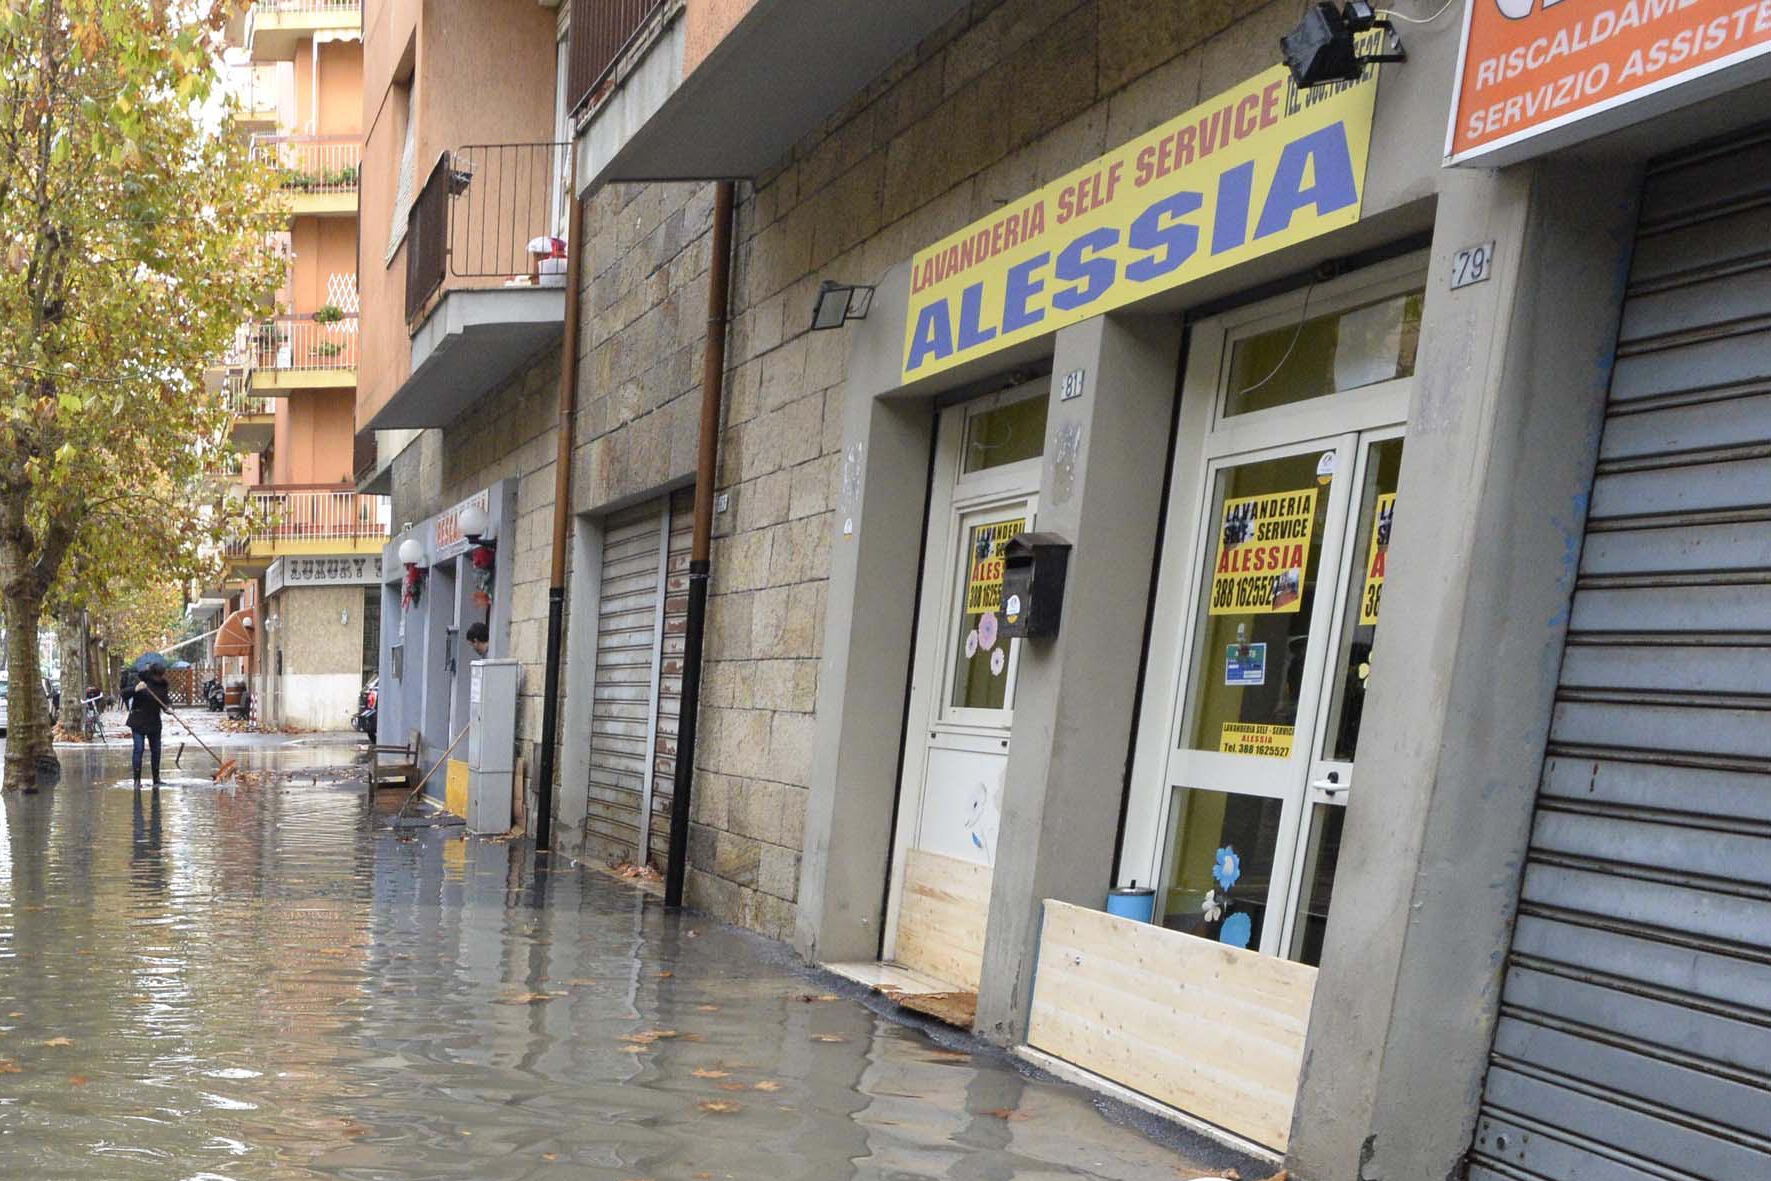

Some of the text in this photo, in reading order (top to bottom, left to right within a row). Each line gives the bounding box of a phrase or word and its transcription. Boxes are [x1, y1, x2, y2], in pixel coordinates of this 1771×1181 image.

[1466, 62, 1611, 140] SERVIZIO
[1617, 0, 1771, 84] ASSISTE
[911, 200, 1045, 296] LAVANDERIA
[1056, 160, 1125, 225] SELF
[1134, 79, 1283, 188] SERVICE
[904, 119, 1359, 372] ALESSIA
[1458, 248, 1485, 285] 79
[1065, 373, 1078, 397] 81
[1225, 495, 1312, 523] LAVANDERIA
[977, 523, 1025, 541] LAVANDERI
[1257, 518, 1308, 541] SERVICE
[291, 559, 366, 580] LUXURY
[1217, 544, 1303, 574] ALESSIA
[1213, 576, 1234, 608] 388
[1224, 742, 1290, 757] Tel. 388 1625527
[1241, 735, 1272, 744] ALESSIA
